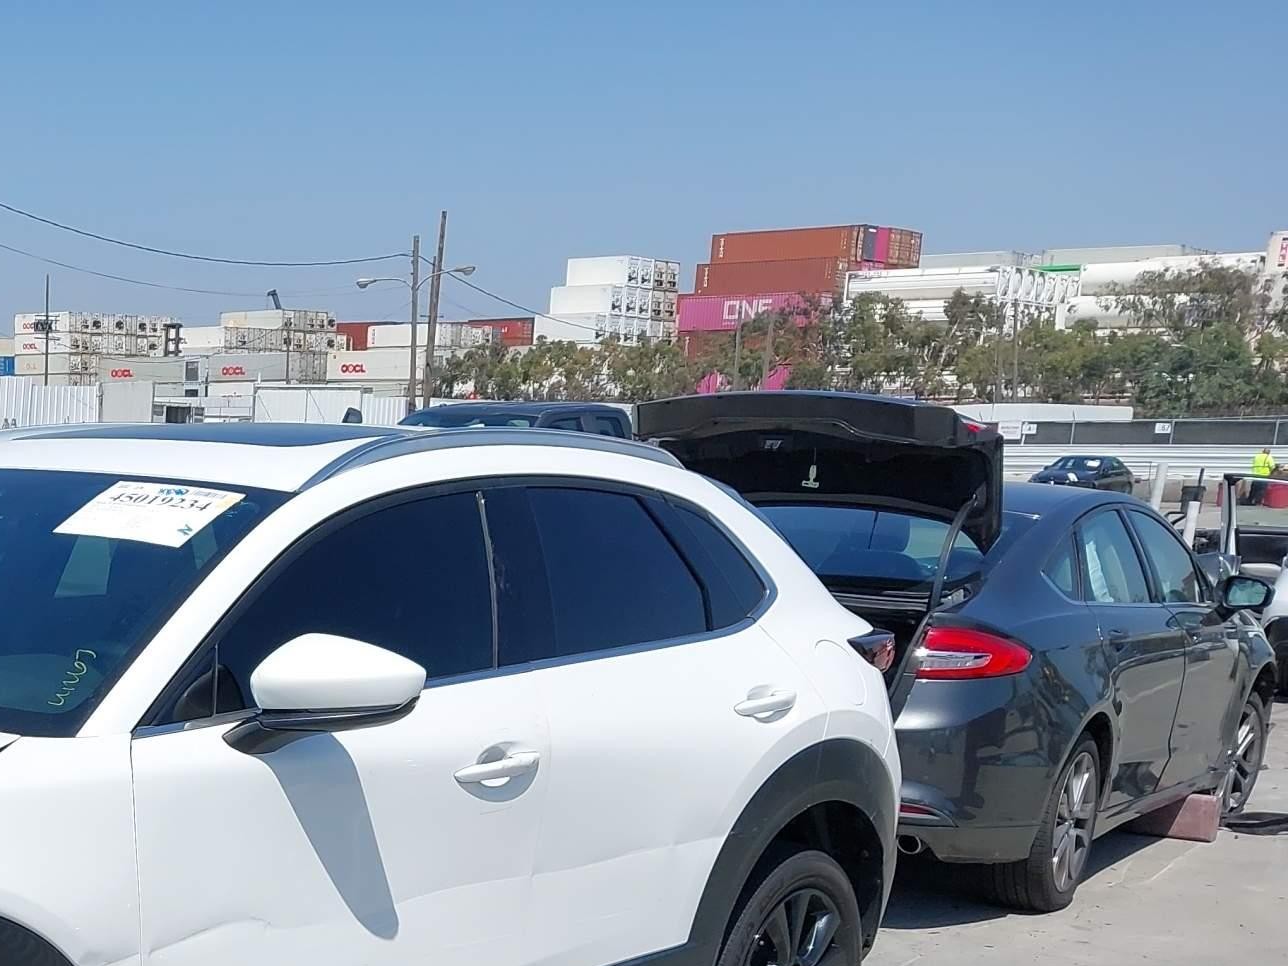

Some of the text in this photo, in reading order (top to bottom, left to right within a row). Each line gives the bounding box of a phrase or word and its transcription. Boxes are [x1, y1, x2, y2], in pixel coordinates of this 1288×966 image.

[222, 366, 245, 376] OOCL
[341, 364, 365, 373] OOCL
[111, 369, 133, 378] OOCL
[109, 492, 212, 511] 45019234
